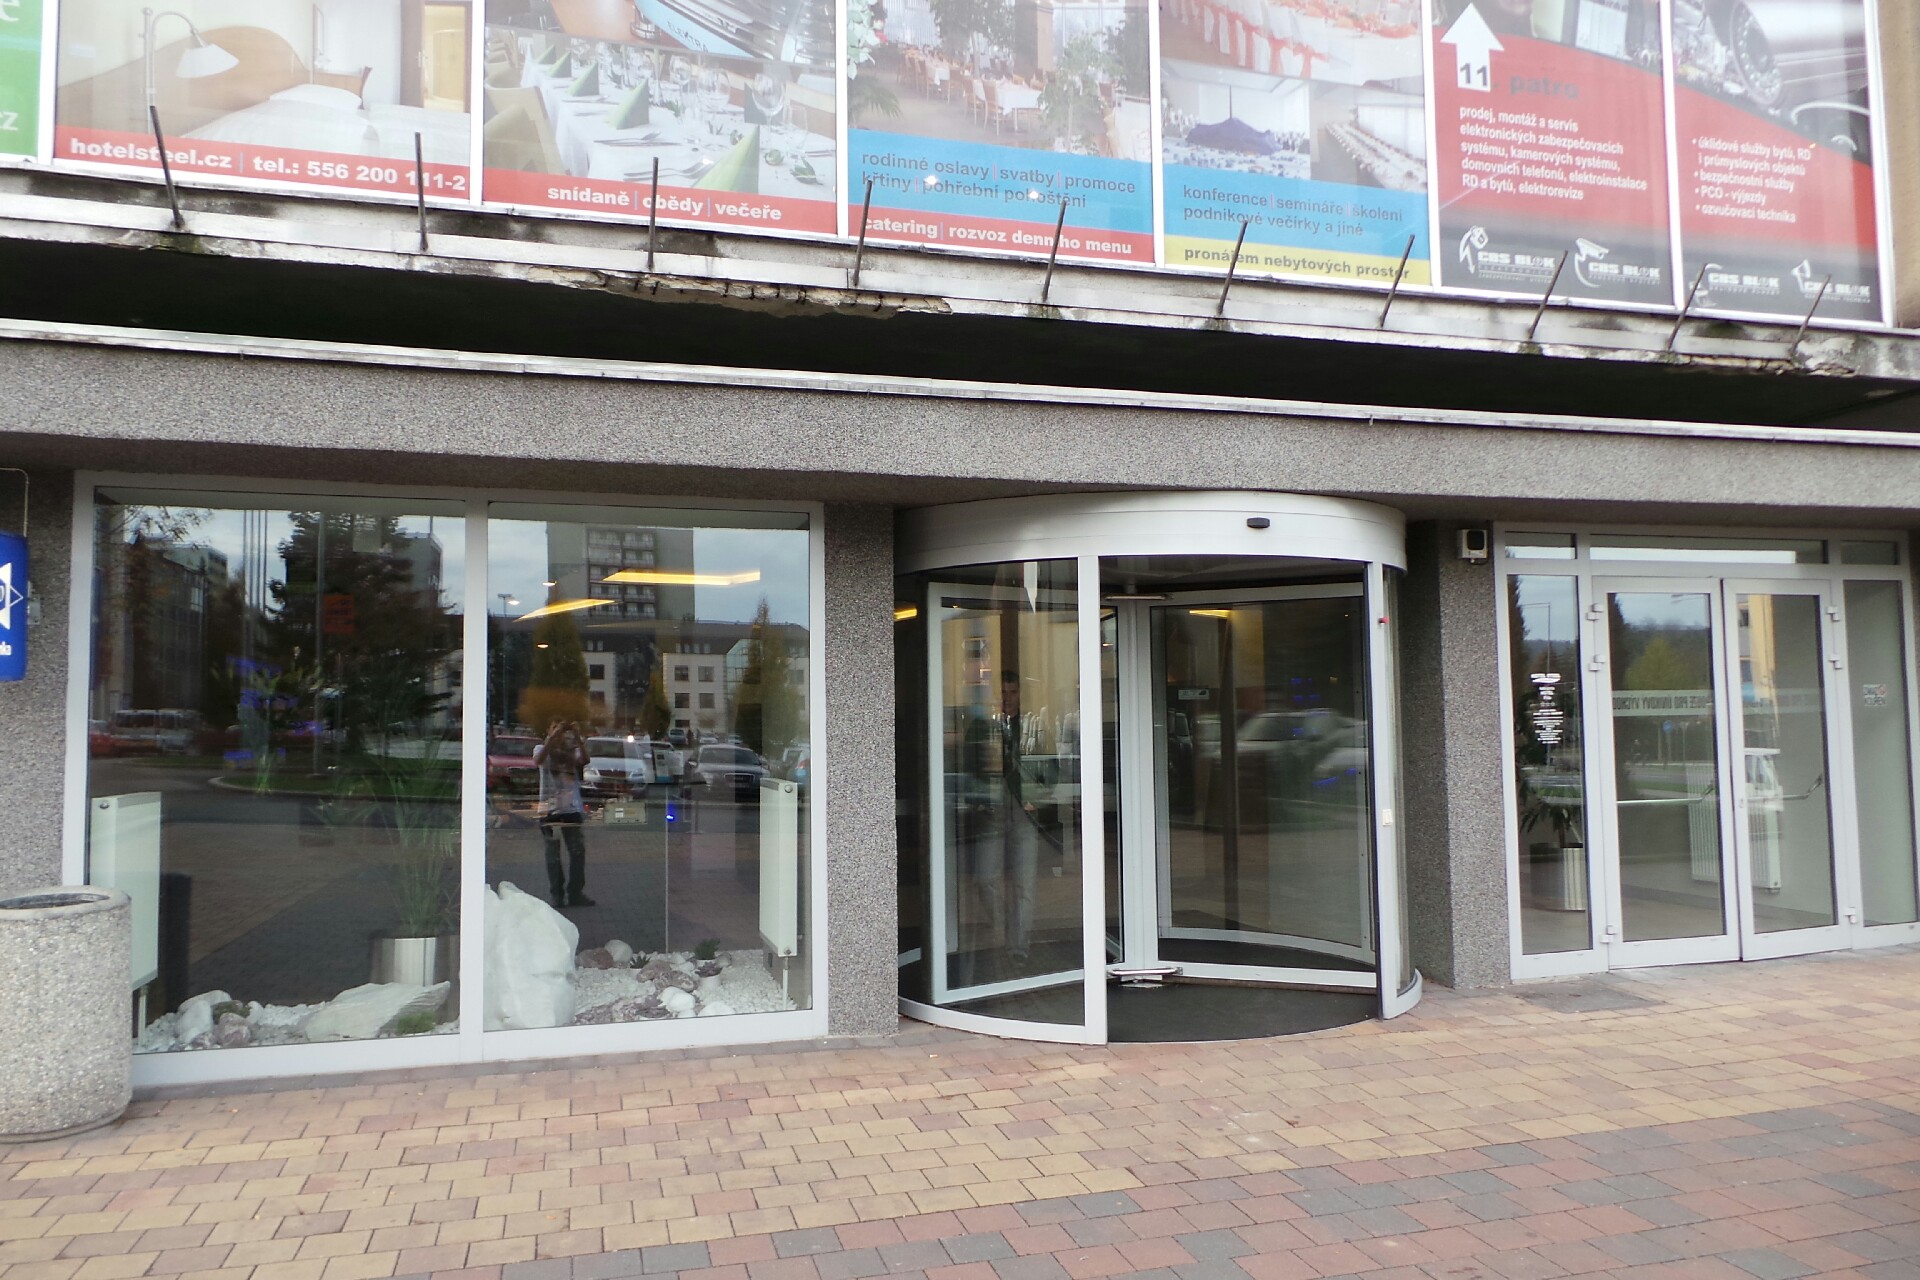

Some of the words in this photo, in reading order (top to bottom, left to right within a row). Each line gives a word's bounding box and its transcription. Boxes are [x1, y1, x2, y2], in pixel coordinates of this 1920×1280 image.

[1510, 75, 1578, 98] patro
[1460, 107, 1495, 123] prodej,
[1498, 112, 1537, 126] montáž
[1539, 118, 1545, 128] a
[1548, 119, 1578, 132] servis
[1460, 123, 1536, 144] elektronických
[1538, 133, 1623, 154] zabezpečovacích
[70, 138, 232, 168] hotelsteel.cz
[253, 156, 300, 174] tel.:
[307, 161, 349, 179] 556
[356, 166, 398, 184] 200
[405, 170, 466, 191] 111-2
[1510, 145, 1573, 165] kamerových
[862, 153, 928, 171] rodinné
[934, 160, 989, 180] oslavy
[1000, 168, 1054, 188] svatby
[1065, 176, 1136, 193] promoce
[862, 171, 911, 193] křtiny
[1461, 157, 1520, 175] domovních
[1569, 170, 1647, 190] elektroinstalace
[1462, 174, 1478, 188] RD
[1481, 178, 1487, 188] a
[1519, 181, 1584, 199] elektrorevize
[547, 186, 630, 206] snídaně
[642, 194, 704, 216] obědy
[715, 202, 782, 220] večeře
[1183, 184, 1267, 206] konference
[1276, 198, 1343, 215] semináře
[1353, 203, 1403, 221] školení
[1184, 207, 1263, 225] podnikové
[1267, 215, 1320, 234] večírky
[1325, 223, 1333, 233] a
[1337, 221, 1364, 237] jiné
[949, 226, 1007, 242] rozvoz
[1012, 230, 1081, 249] dennho
[1085, 239, 1132, 254] menu
[1184, 248, 1259, 264] pronáem
[1264, 255, 1351, 274] nebytových
